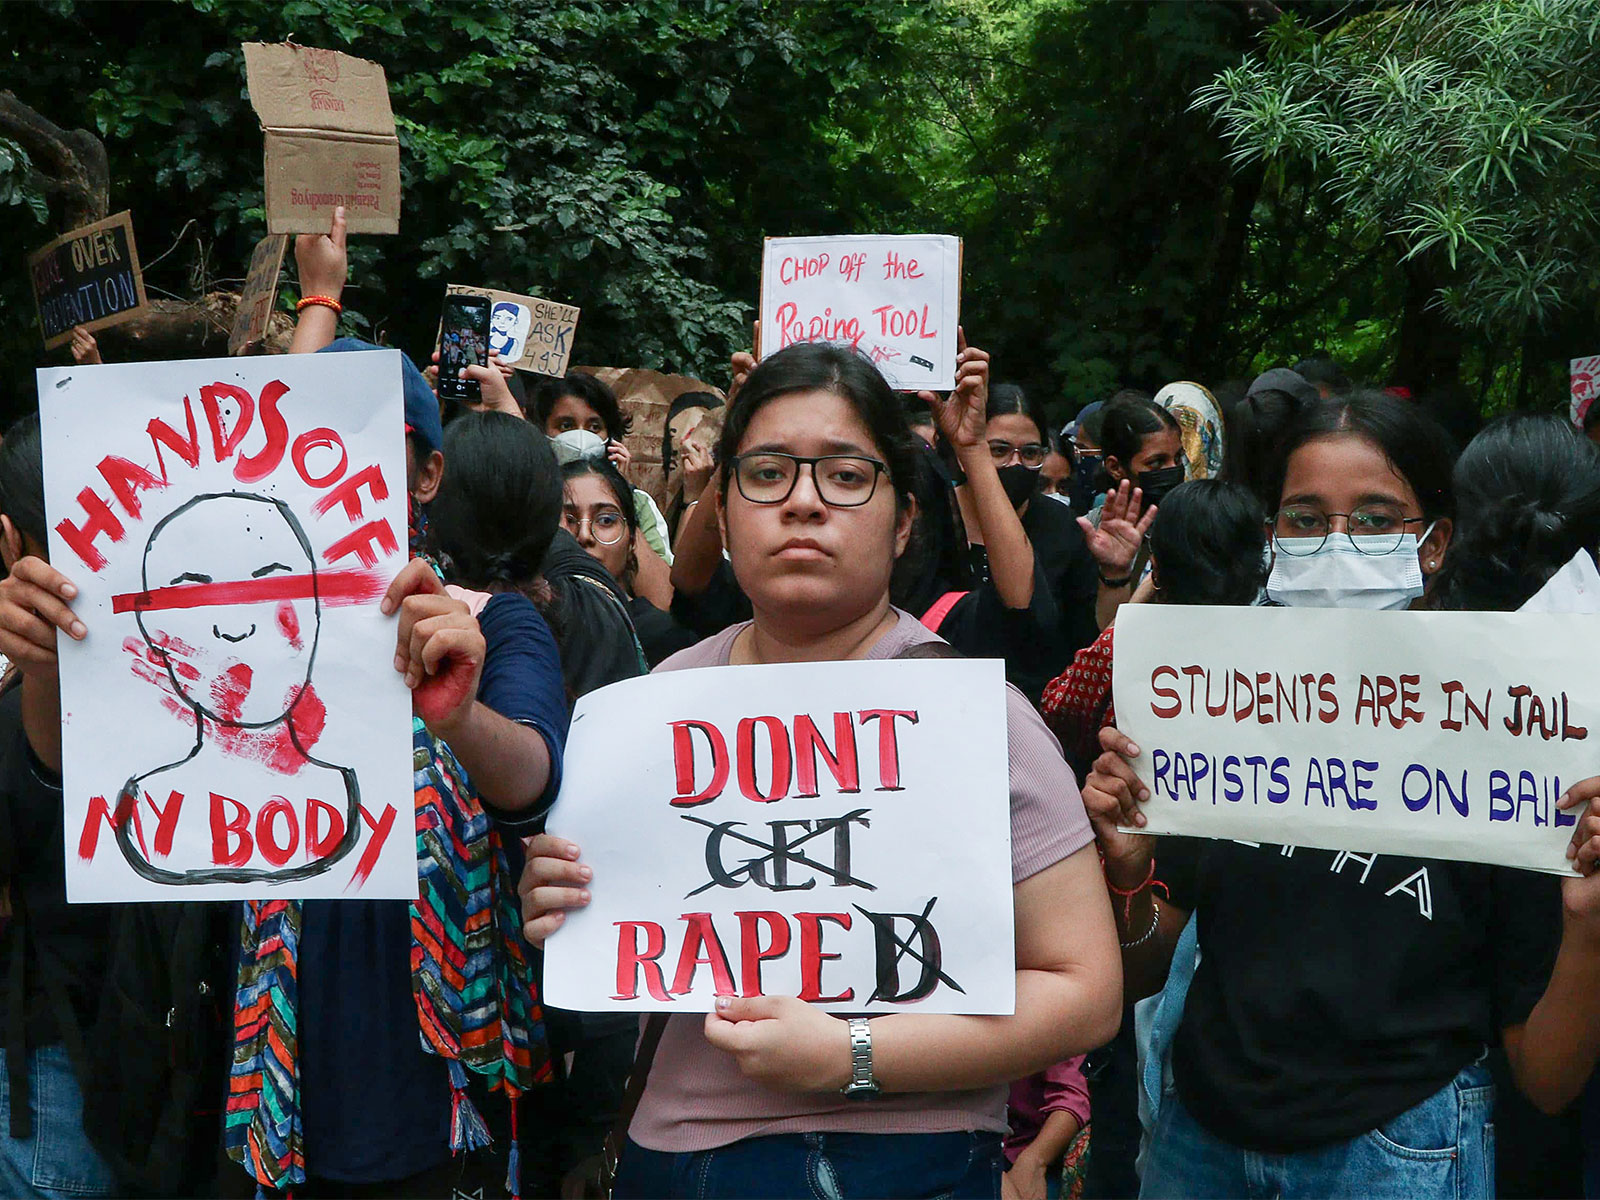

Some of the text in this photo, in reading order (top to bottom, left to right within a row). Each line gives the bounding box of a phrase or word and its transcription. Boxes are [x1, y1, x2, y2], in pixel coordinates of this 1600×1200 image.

[71, 229, 121, 272] OVER
[780, 253, 830, 285] CHOP
[883, 250, 925, 281] the
[528, 321, 572, 354] ASK
[775, 302, 938, 352] Raping TOOL
[55, 379, 400, 572] HANDS OFF
[1150, 665, 1589, 742] STUDENTS ARE IN JAIL
[666, 709, 920, 808] DONT
[1153, 749, 1577, 827] RAPISTS ARE ON BAIL
[78, 789, 398, 894] MY BODY
[703, 812, 872, 893] GET
[609, 908, 943, 1005] RAPED
